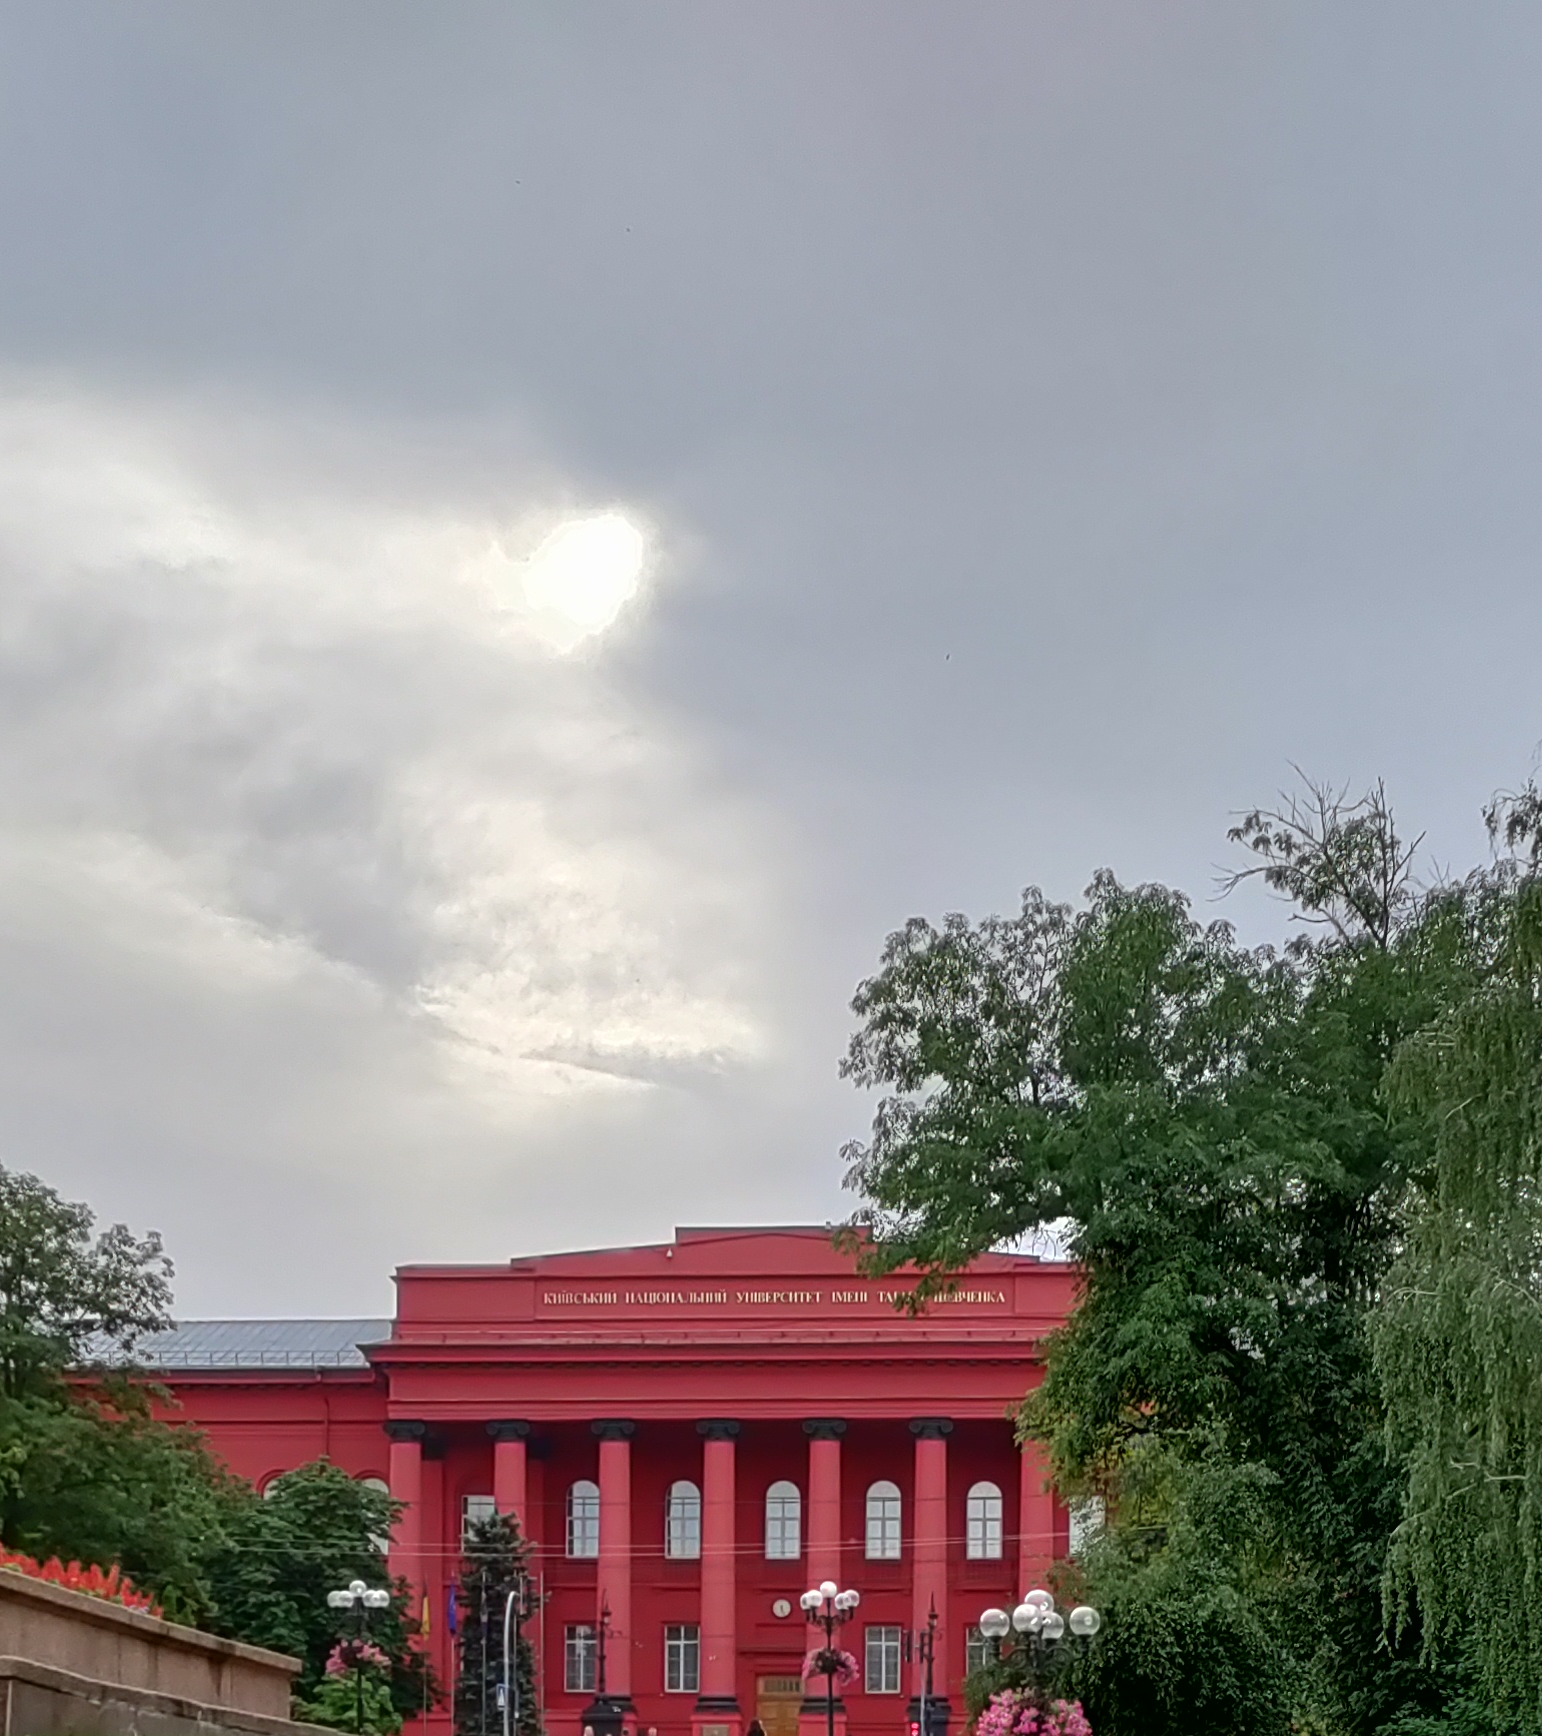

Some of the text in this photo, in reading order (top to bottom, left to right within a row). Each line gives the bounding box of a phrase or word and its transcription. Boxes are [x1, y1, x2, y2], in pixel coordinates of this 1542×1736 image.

[544, 1290, 617, 1304] КИЇВСЬКИЙ
[625, 1289, 727, 1304] НАЦІОНАЛЬНИЙ
[736, 1291, 822, 1304] УНІВЕРСИТЕТ
[832, 1291, 868, 1303] ІМЕНІ
